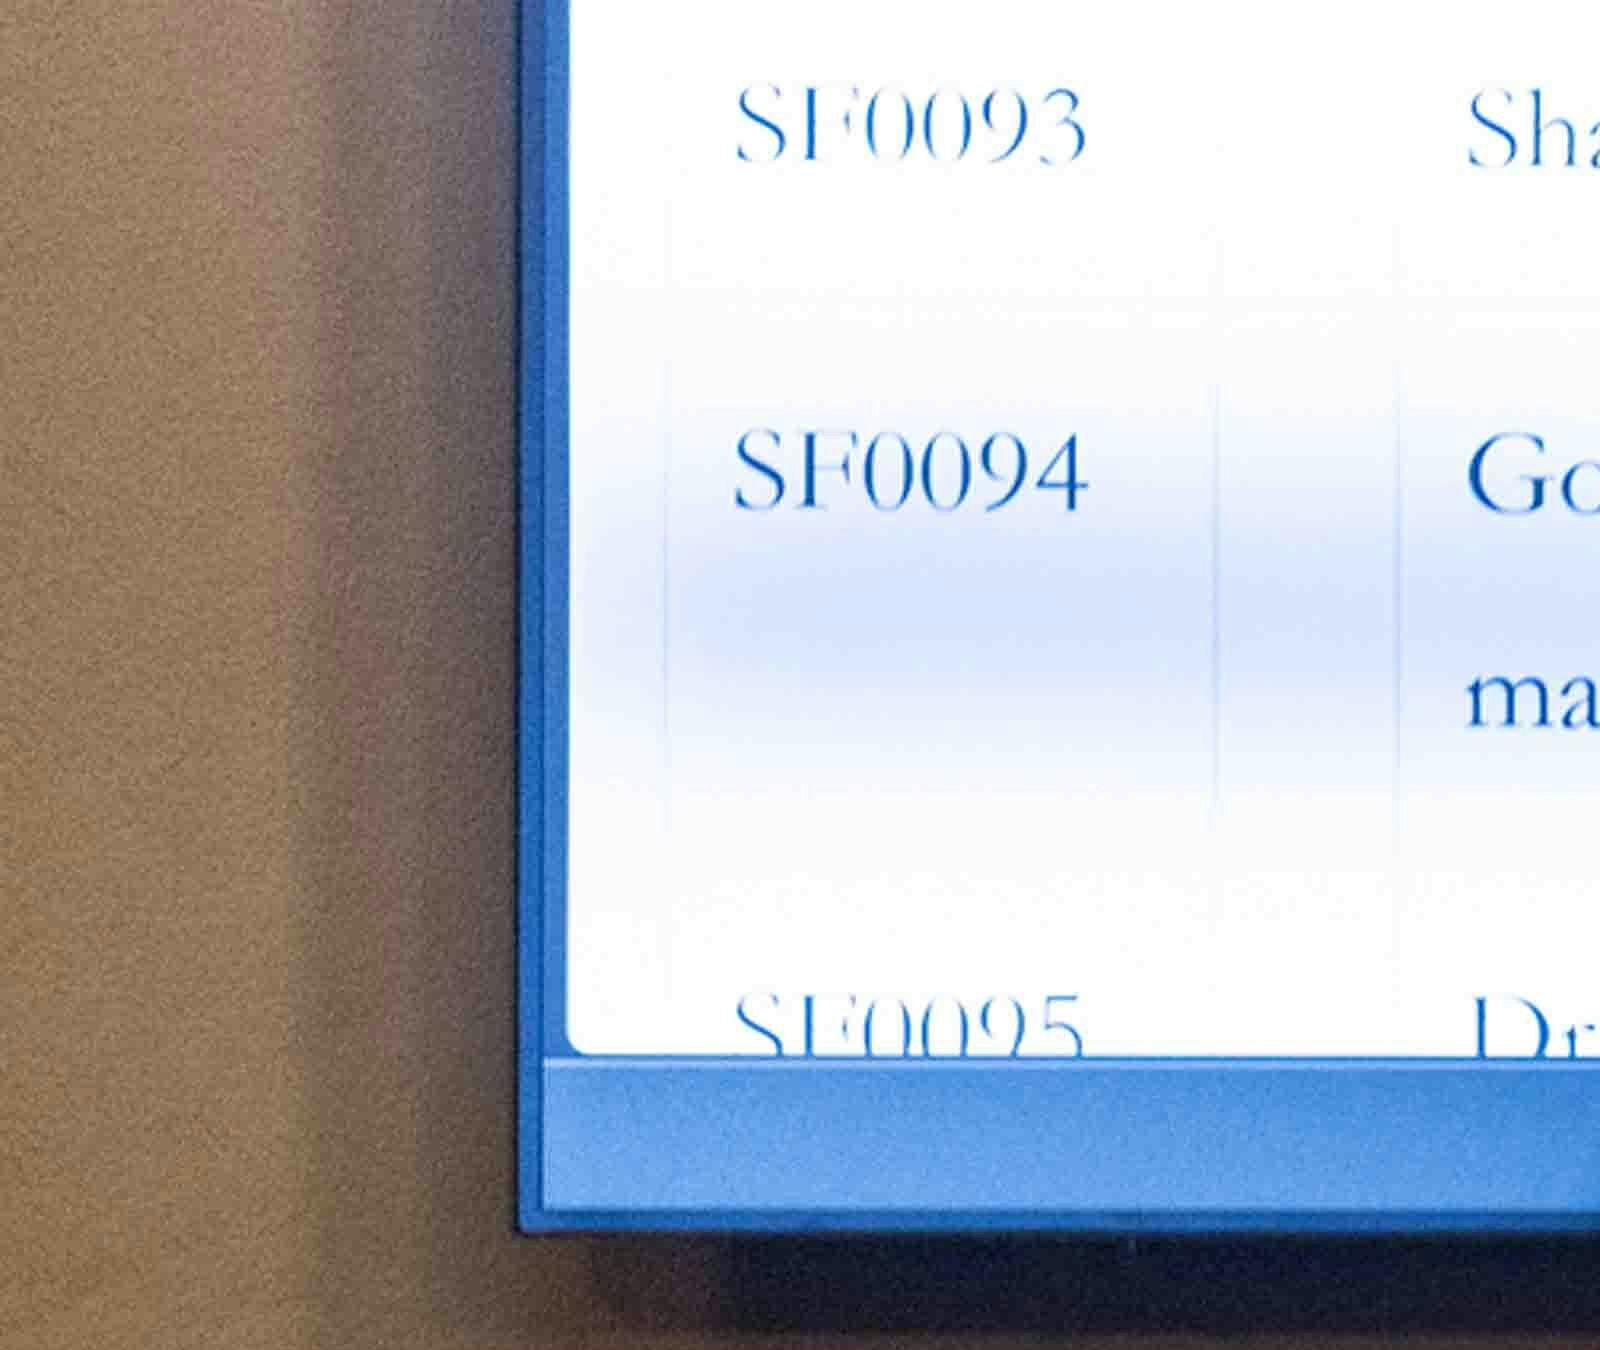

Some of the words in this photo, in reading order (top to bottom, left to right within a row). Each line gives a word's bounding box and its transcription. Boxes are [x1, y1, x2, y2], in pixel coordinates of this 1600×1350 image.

[734, 83, 1088, 166] SF0093
[733, 428, 1090, 514] SF0094
[735, 991, 1084, 1056] SF0095
